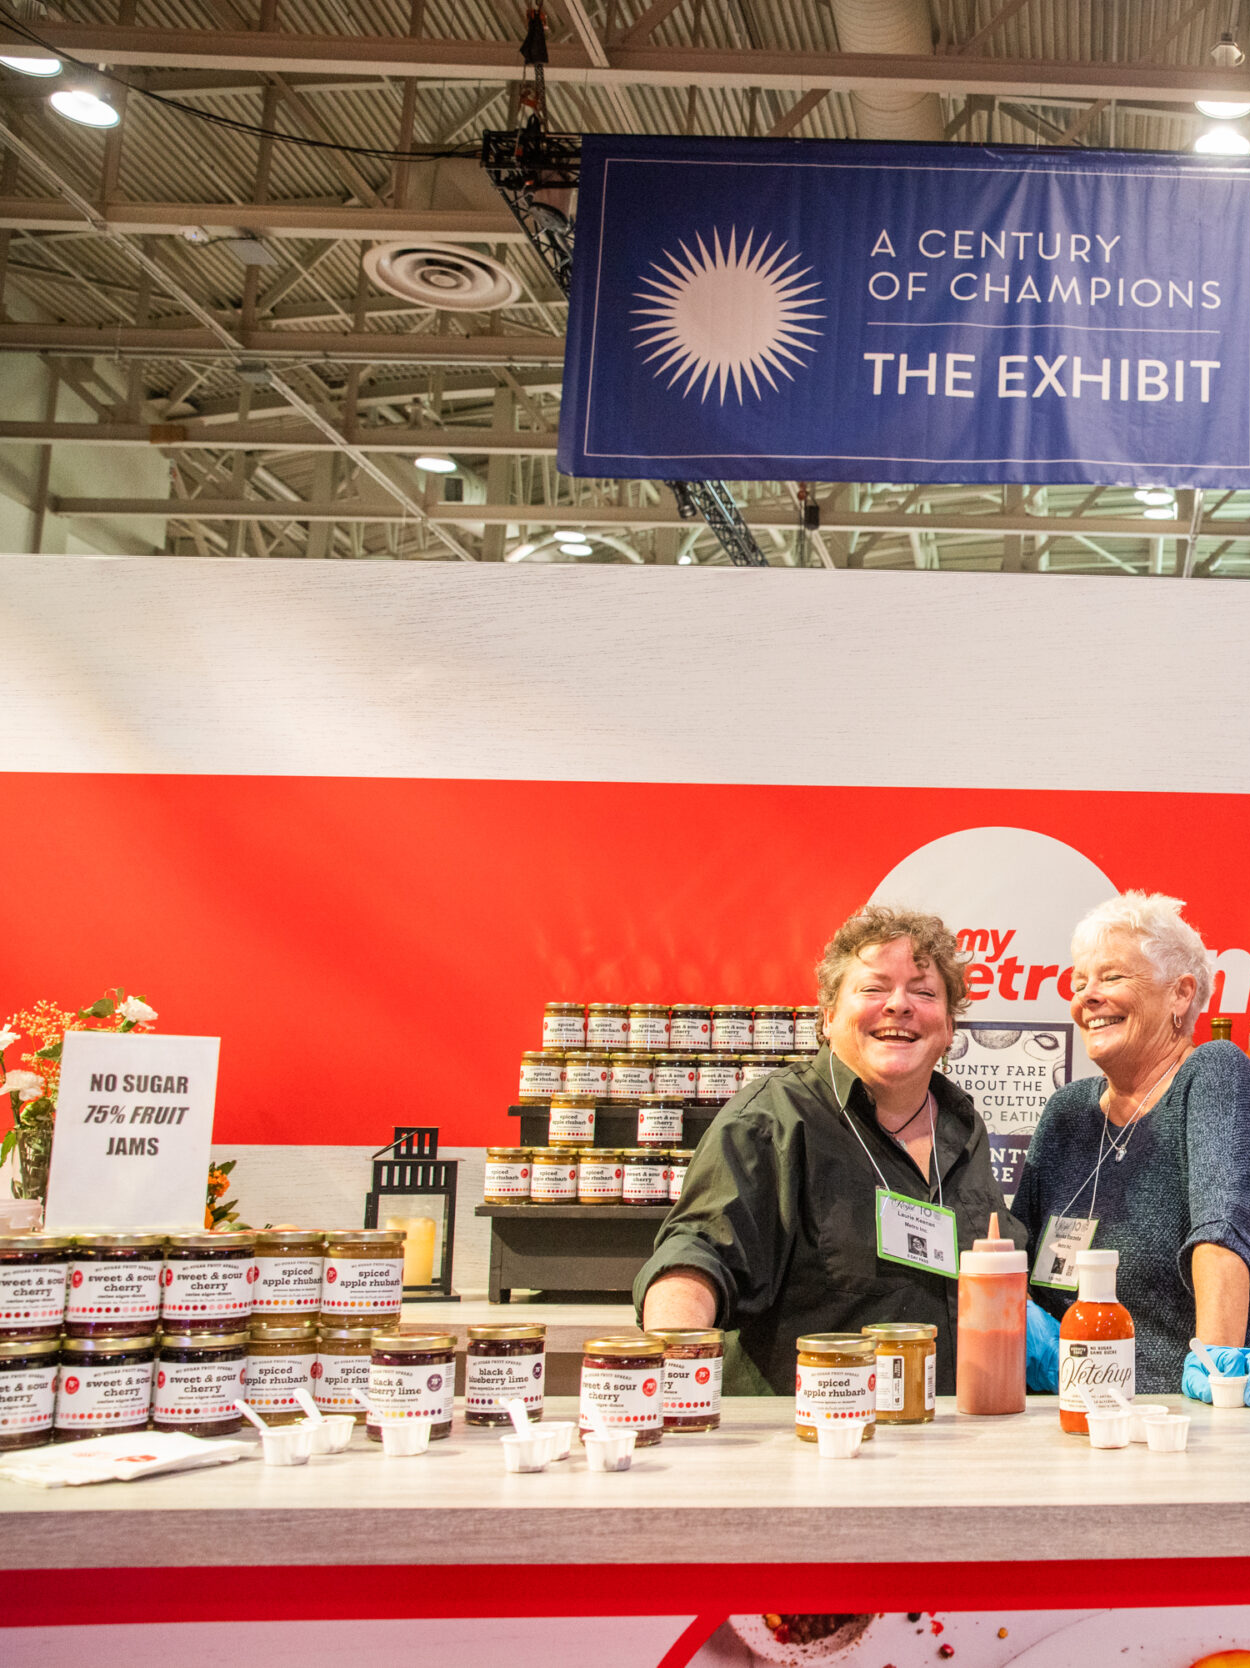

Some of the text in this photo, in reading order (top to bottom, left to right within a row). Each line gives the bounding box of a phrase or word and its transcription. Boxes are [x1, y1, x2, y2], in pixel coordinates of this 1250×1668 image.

[871, 229, 1121, 264] A CENTURY
[868, 271, 1222, 310] OF CHAMPIONS
[864, 353, 1222, 403] THE EXHIBIT
[957, 928, 1017, 964] my
[938, 1064, 1047, 1077] OUNTY FARE
[90, 1073, 189, 1094] NO SUGAR
[1013, 1080, 1042, 1092] THE
[983, 1095, 1048, 1107] CULTUR
[84, 1105, 190, 1125] 75% FRUIT
[106, 1137, 160, 1156] JAMS
[904, 1222, 919, 1231] Metro
[177, 1271, 243, 1281] sweet & sour
[282, 1267, 313, 1277] spiced
[358, 1269, 390, 1279] spiced
[36, 1276, 45, 1286] &
[88, 1273, 156, 1283] sweet & sour
[262, 1278, 291, 1287] apple
[104, 1284, 143, 1293] cherry
[190, 1281, 228, 1291] cherry
[340, 1279, 400, 1288] apple rhubarb
[13, 1287, 53, 1297] cherry
[258, 1366, 293, 1376] spiced
[479, 1367, 513, 1376] black &
[667, 1371, 690, 1379] sour
[1061, 1356, 1132, 1392] Ketchup
[86, 1377, 134, 1389] sweet &
[170, 1374, 237, 1384] sweet & sour
[269, 1375, 308, 1384] rhubarb
[325, 1377, 349, 1385] apple
[395, 1378, 403, 1387] &
[817, 1378, 851, 1388] spiced
[14, 1383, 23, 1392] &
[184, 1384, 222, 1394] cherry
[398, 1387, 422, 1395] lime
[603, 1382, 637, 1391] & sour
[103, 1388, 141, 1398] cherry
[588, 1392, 620, 1402] cherry
[803, 1387, 866, 1398] apple rhubarb
